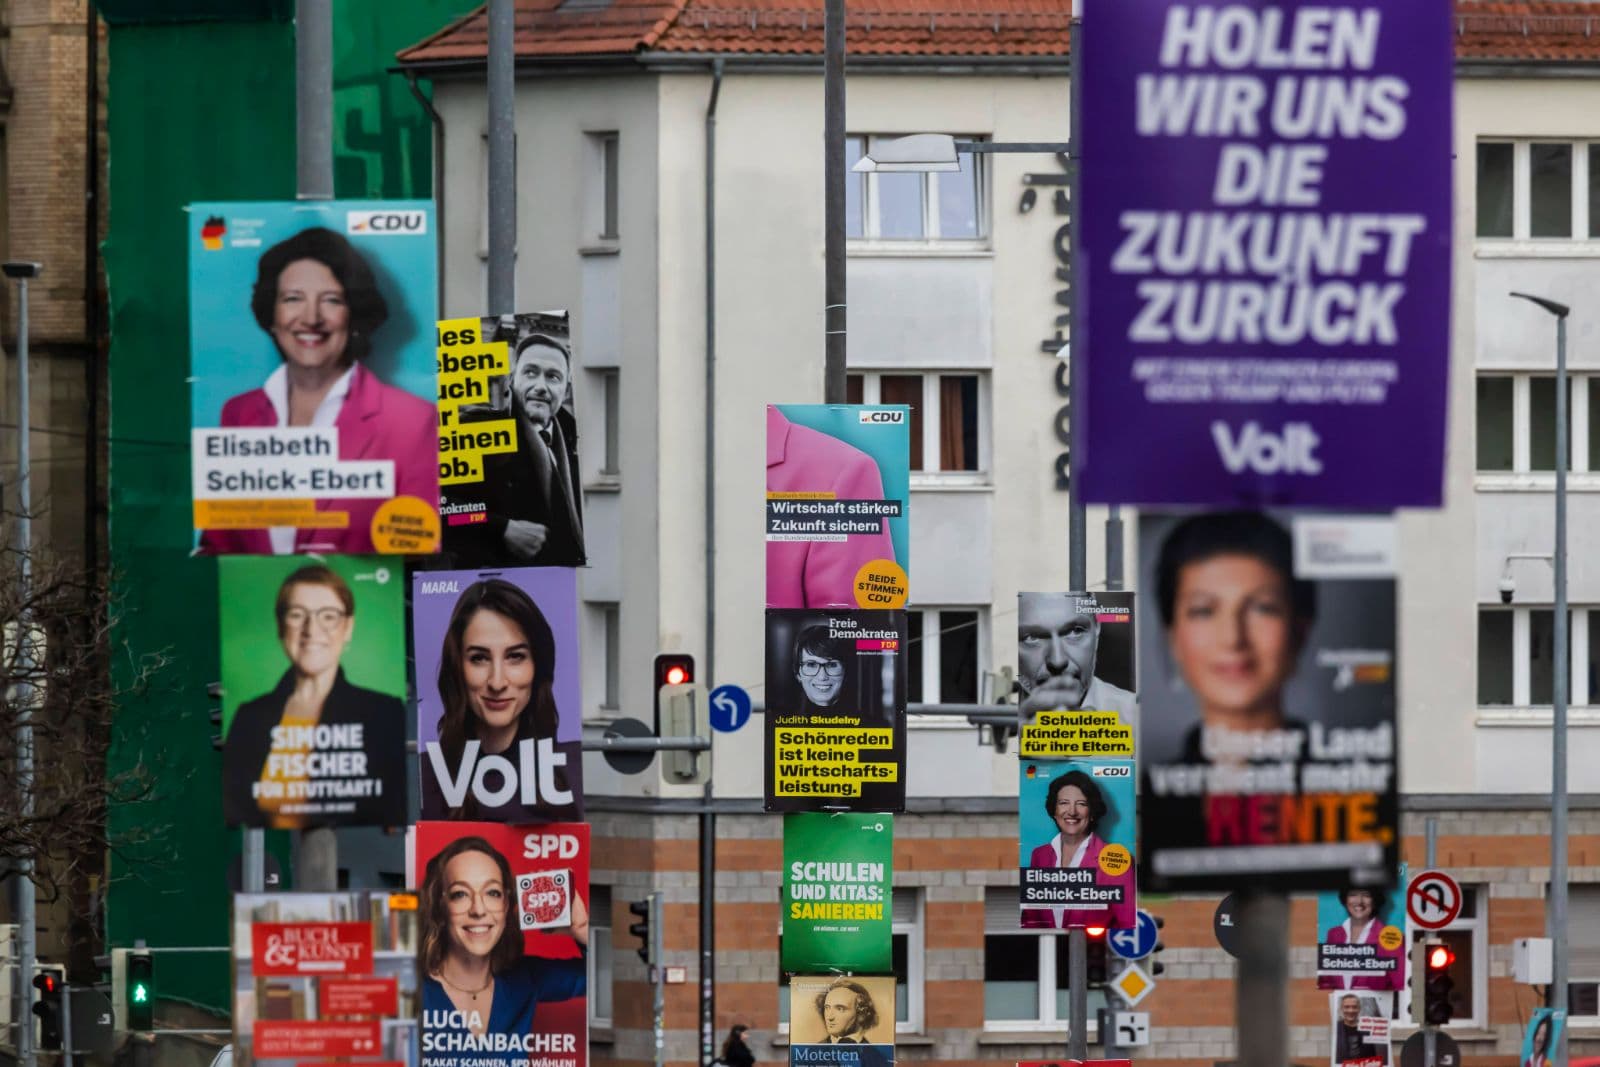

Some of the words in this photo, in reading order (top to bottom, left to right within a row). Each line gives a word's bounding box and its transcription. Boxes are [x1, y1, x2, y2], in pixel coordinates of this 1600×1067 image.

[1159, 6, 1380, 69] HOLEN
[1135, 73, 1266, 137] WIR
[1270, 77, 1409, 139] UNS
[1213, 144, 1327, 206] DIE
[369, 214, 422, 231] CDU
[1110, 210, 1427, 276] ZUKUNFT
[1128, 270, 1405, 345] ZURÜCK
[437, 352, 503, 373] ben.
[871, 412, 902, 422] CDU
[206, 436, 332, 458] Elisabeth
[1211, 420, 1323, 471] Volt
[206, 470, 385, 492] Schick-Ebert
[772, 502, 846, 514] Wirtschaft
[848, 502, 899, 514] stärken
[772, 519, 827, 532] Zukunft
[829, 519, 880, 532] sichern
[868, 574, 897, 584] BEIDE
[421, 581, 460, 594] MARAL
[858, 582, 905, 596] STIMMEN
[867, 593, 893, 603] CDU
[1075, 597, 1097, 606] Freie
[1075, 604, 1130, 614] Demokraten
[829, 617, 857, 628] Freie
[829, 628, 899, 639] Demokraten
[880, 641, 897, 649] FDP
[775, 715, 808, 725] Judith
[810, 715, 860, 726] Skudelny
[1040, 715, 1116, 726] Schulden:
[270, 723, 364, 750] SIMONE
[779, 732, 890, 746] Schönreden
[1027, 728, 1076, 739] Kinder
[1079, 728, 1129, 739] haften
[1309, 720, 1393, 760] Land
[1025, 741, 1047, 752] für
[1050, 741, 1079, 752] ihre
[1082, 741, 1131, 752] Eltern.
[779, 748, 803, 761] ist
[806, 748, 855, 761] keine
[268, 751, 368, 778] FISCHER
[779, 764, 894, 778] Wirtschafts-
[425, 737, 574, 808] Volt
[1103, 768, 1129, 776] CDU
[286, 778, 374, 799] STUTTGART
[779, 780, 858, 796] leistung.
[1207, 792, 1394, 846] RENTE.
[523, 833, 580, 859] SPD
[791, 861, 884, 882] SCHULEN
[1026, 870, 1092, 883] Elisabeth
[791, 883, 827, 900] UND
[830, 885, 884, 901] KITAS:
[1026, 887, 1121, 901] Schick-Ebert
[527, 890, 561, 909] SPD
[791, 902, 884, 920] SANIEREN!
[298, 943, 364, 960] KUNST
[1322, 945, 1375, 955] Elisabeth
[1322, 958, 1396, 969] Schick-Ebert
[423, 1010, 483, 1028] LUCIA
[422, 1033, 577, 1053] SCHANBACHER
[795, 1047, 859, 1061] Motetten
[422, 1058, 458, 1067] PLAKAT
[511, 1058, 530, 1067] SPD
[531, 1057, 576, 1067] WÄHLEN!
